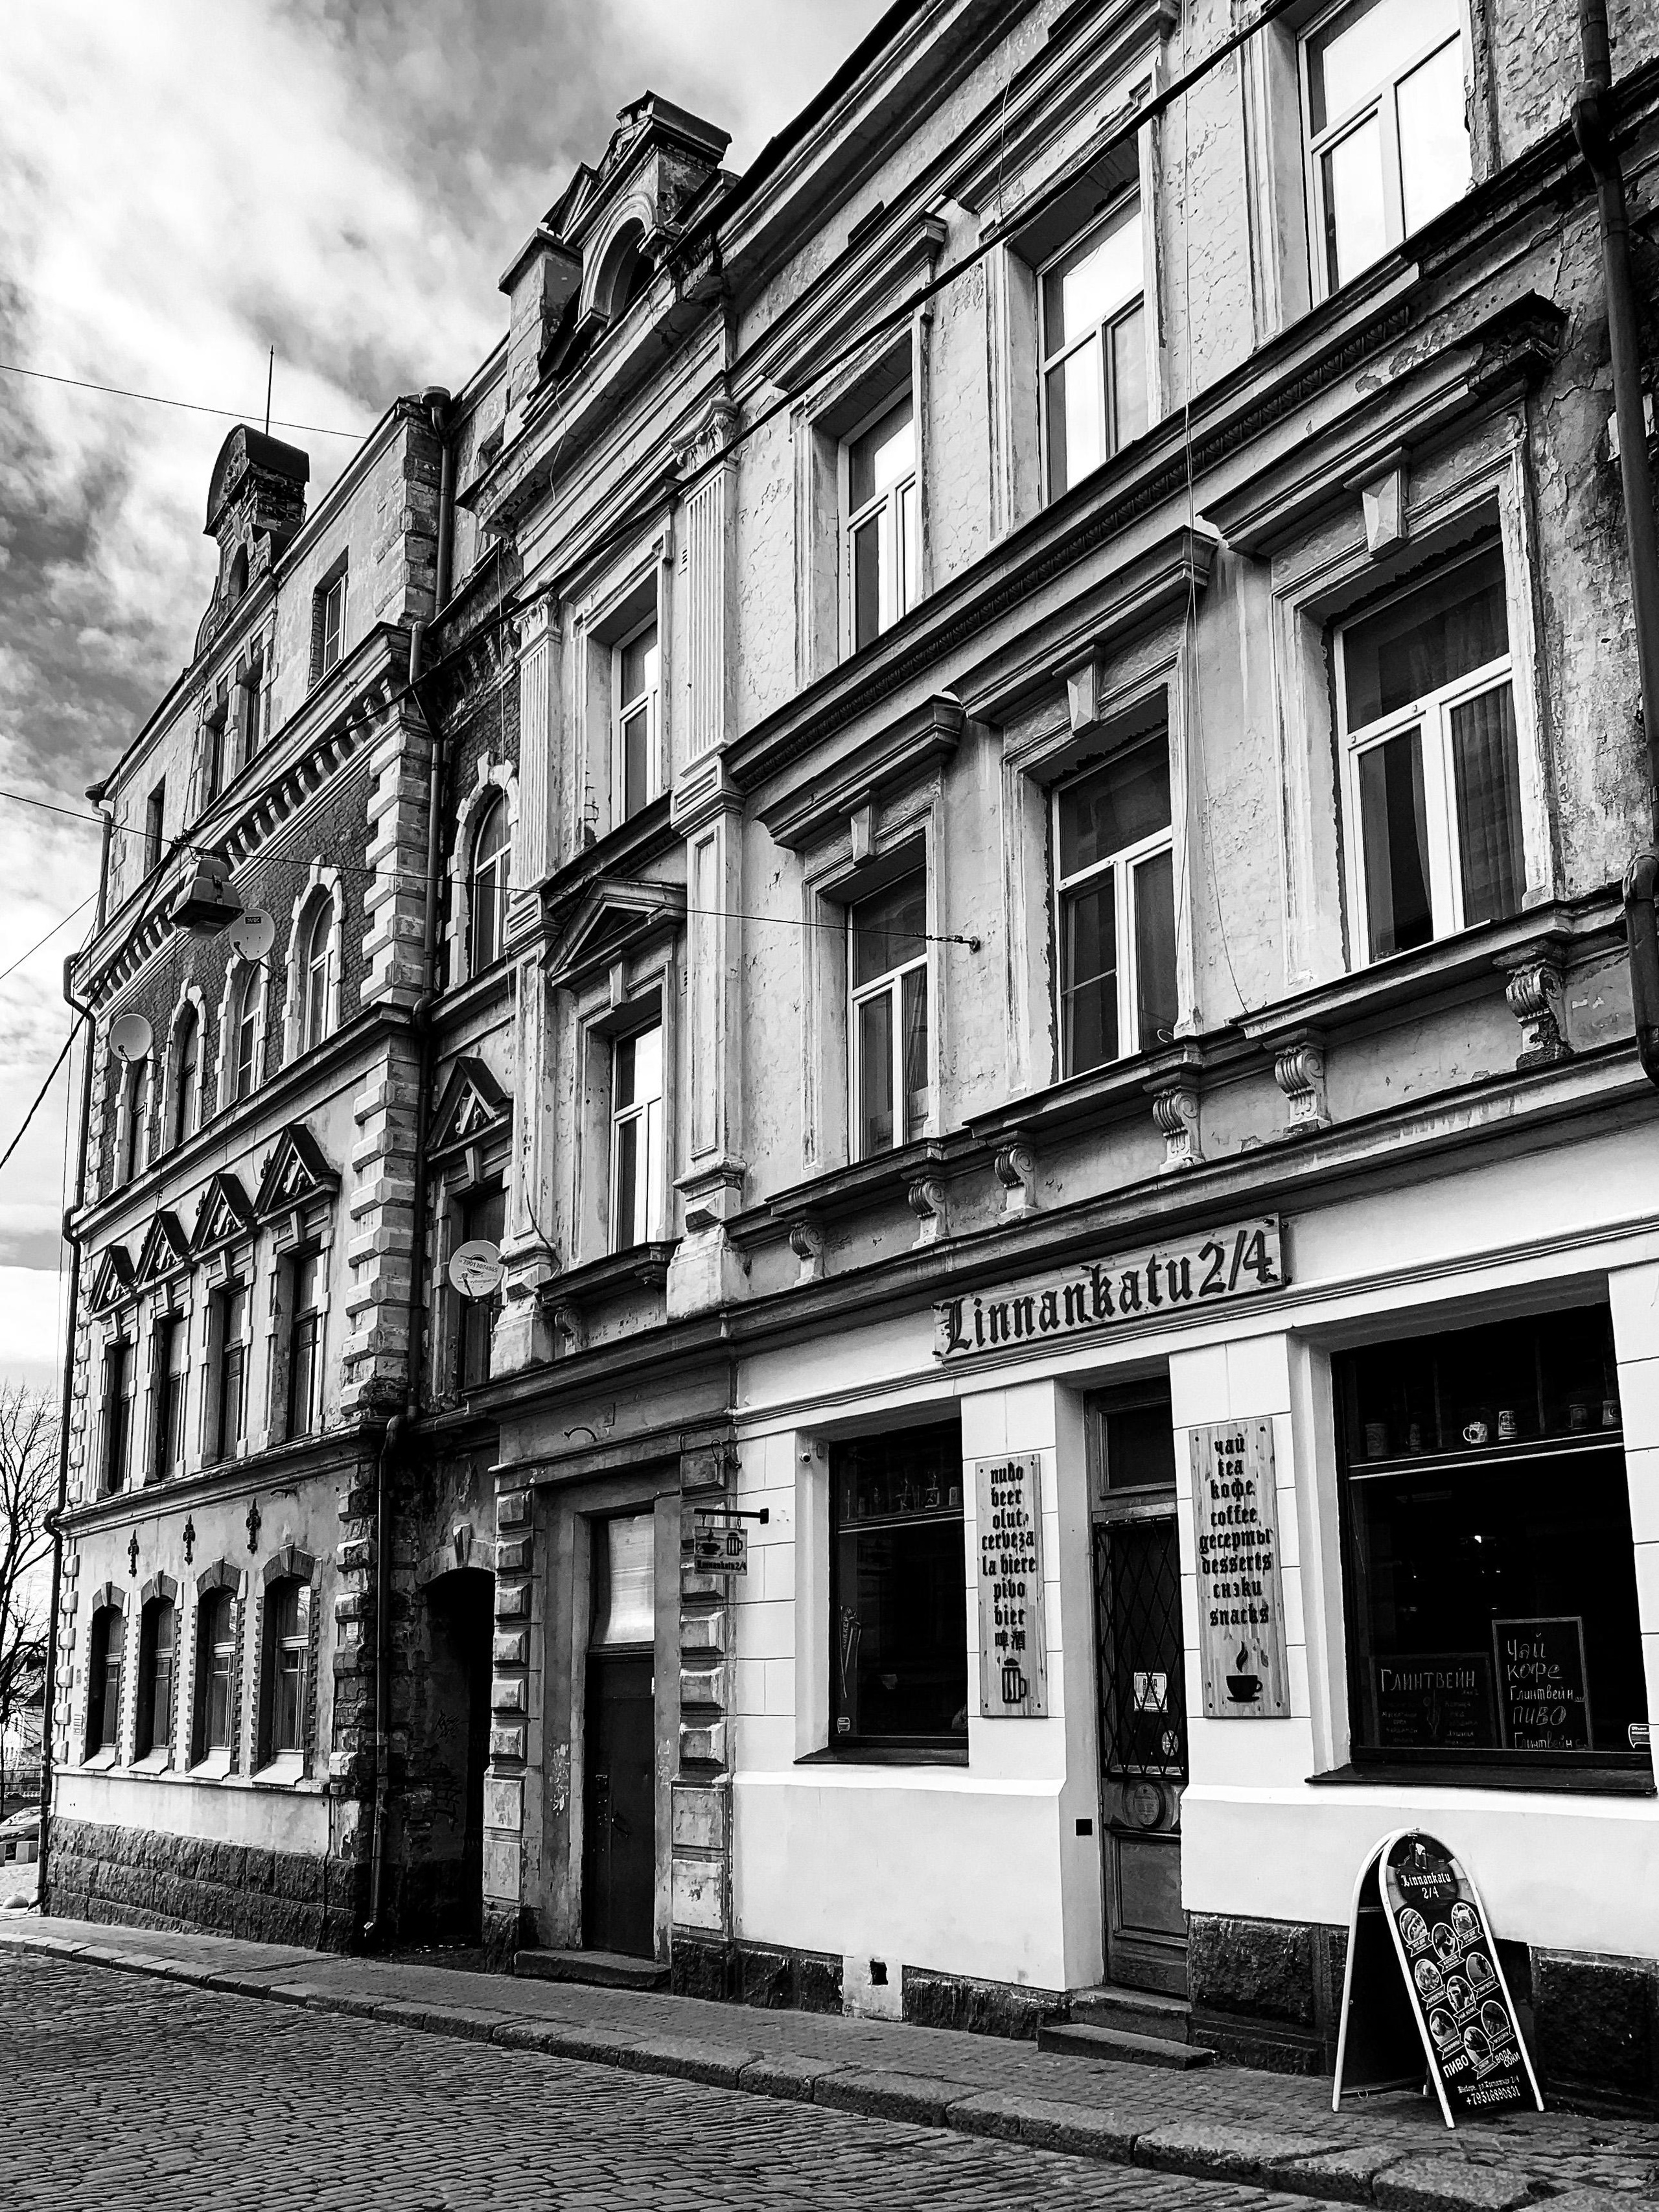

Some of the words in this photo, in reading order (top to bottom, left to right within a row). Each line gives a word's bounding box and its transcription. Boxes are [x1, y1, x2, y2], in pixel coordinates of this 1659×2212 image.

[942, 1253, 1192, 1354] Linnankatu
[1198, 1229, 1273, 1295] 2/4
[1214, 1433, 1245, 1455] чай
[1218, 1458, 1244, 1477] tea
[991, 1487, 1022, 1508] beer
[1210, 1478, 1255, 1501] кофе
[1211, 1506, 1257, 1526] coffee
[981, 1529, 1034, 1554] cerveza
[982, 1555, 997, 1576] la
[1000, 1554, 1036, 1574] biere
[1201, 1552, 1271, 1575] desserts
[993, 1578, 1026, 1603] pivo
[1213, 1576, 1262, 1600] снэки
[994, 1604, 1026, 1626] bier
[1209, 1603, 1270, 1627] snacks
[995, 1630, 1026, 1651] 啤酒
[1143, 1679, 1157, 1687] ВД
[1401, 1872, 1452, 1887] Linnankatu
[1422, 1886, 1439, 1900] 2/4
[1443, 2055, 1469, 2078] ПИВО
[1494, 2048, 1512, 2064] ВОДА
[1503, 2051, 1520, 2067] СОКИ
